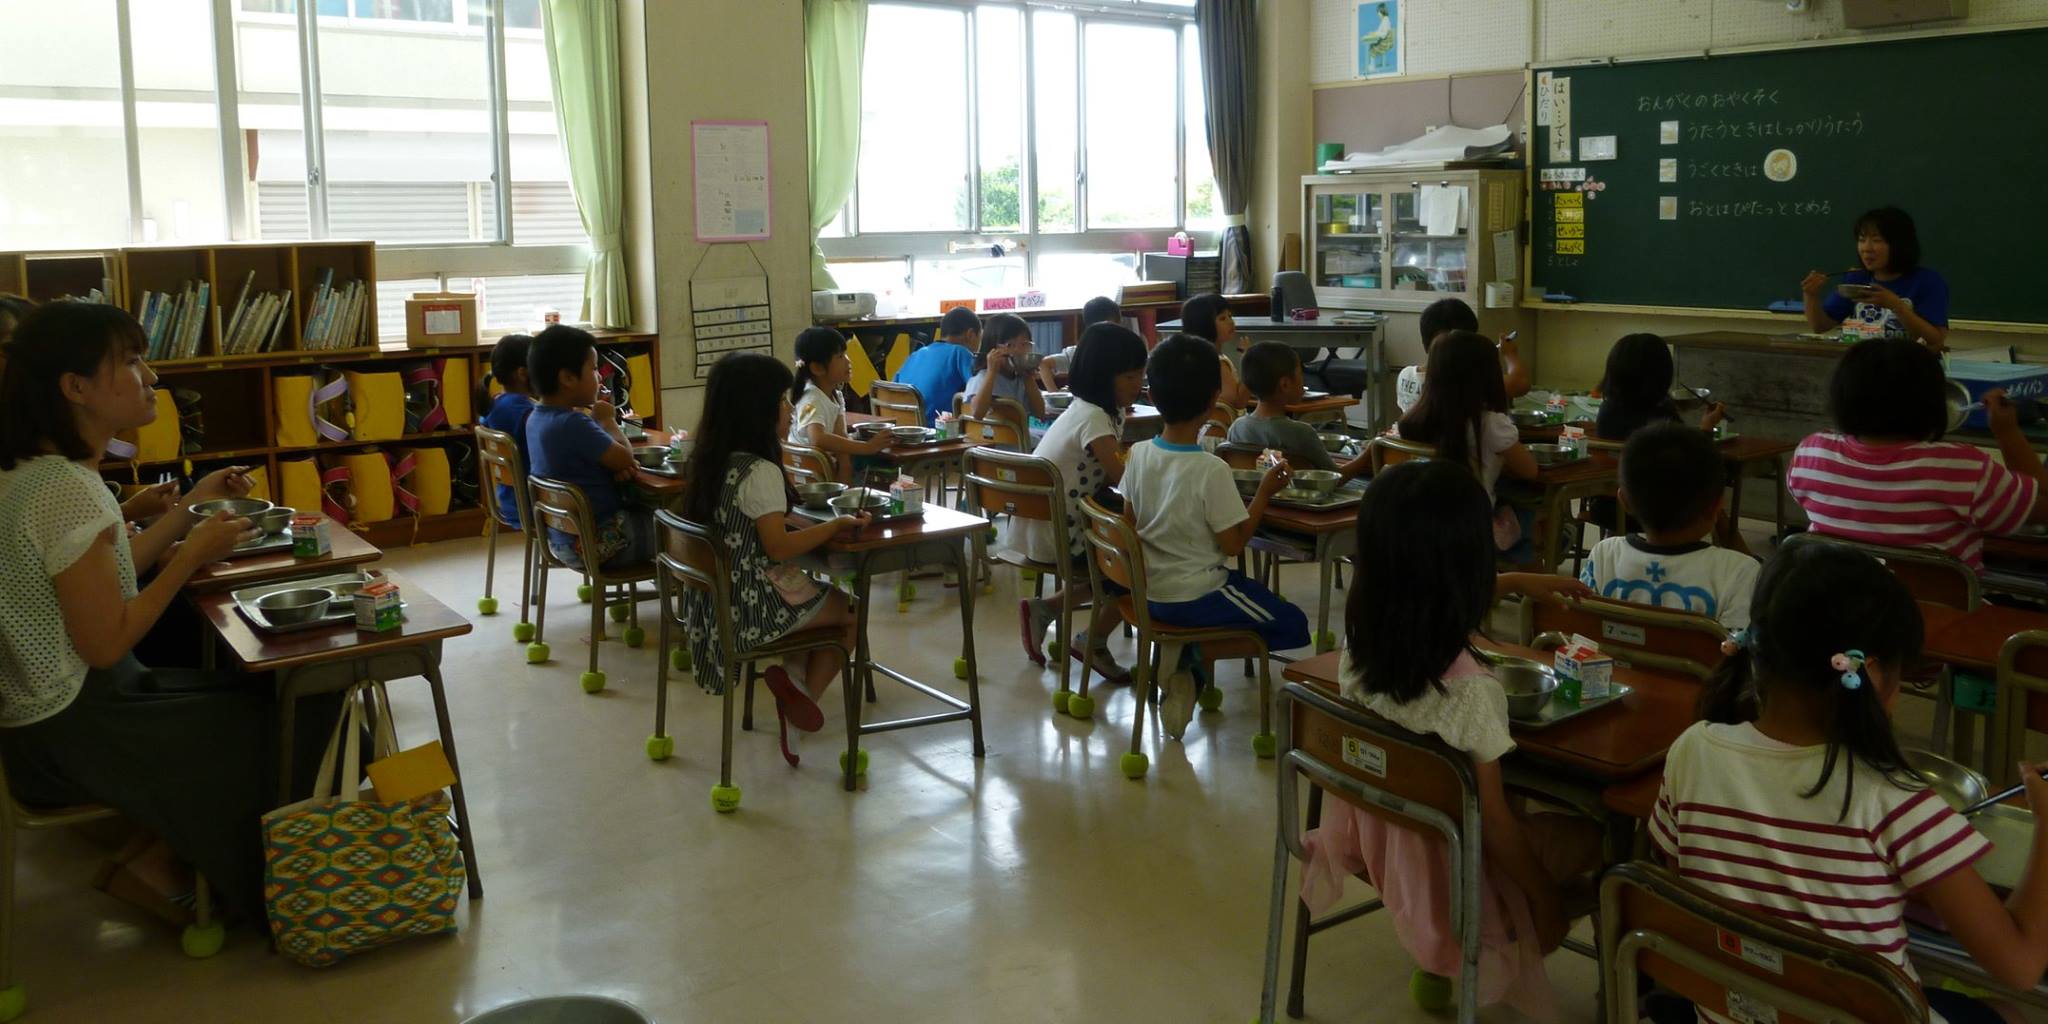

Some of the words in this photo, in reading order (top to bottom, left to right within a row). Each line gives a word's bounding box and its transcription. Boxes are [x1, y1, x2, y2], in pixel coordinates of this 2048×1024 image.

[1638, 88, 1780, 112] おんがくのおやくそく
[1688, 113, 1865, 139] うたうときはしっかりうたう
[1688, 160, 1759, 178] うごくときは
[1348, 740, 1356, 753] 6
